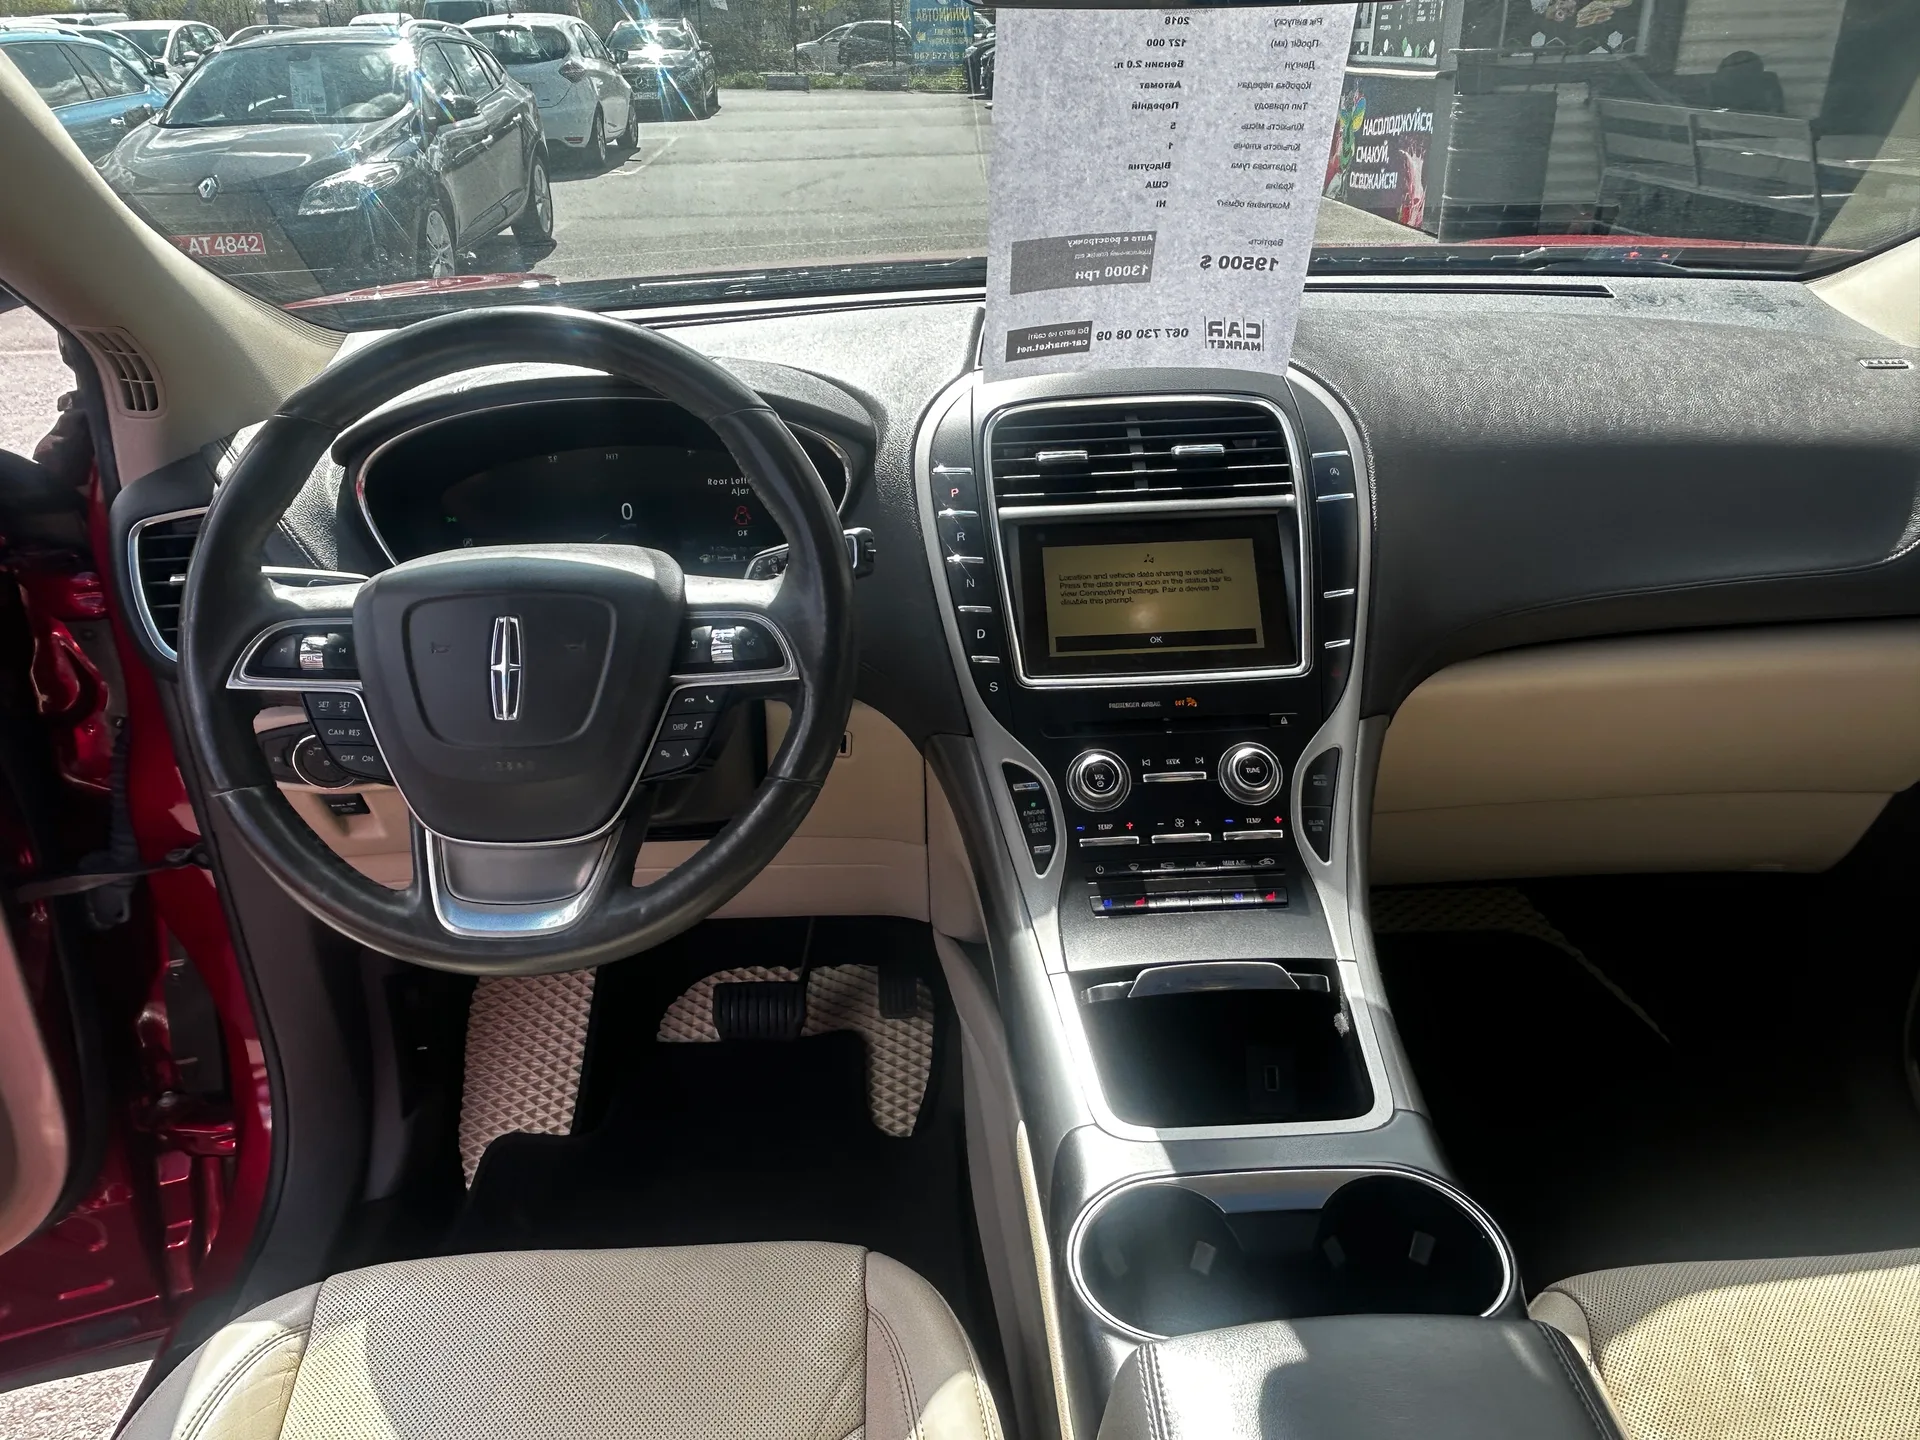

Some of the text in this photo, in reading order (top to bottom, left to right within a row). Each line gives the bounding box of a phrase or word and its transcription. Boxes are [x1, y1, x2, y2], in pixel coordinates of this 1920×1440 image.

[916, 3, 971, 21] АВТОМИЙКА
[1363, 107, 1433, 136] НАСОЛОДЖУЙСЯ,
[1356, 140, 1389, 163] СМАКУЙ,
[189, 235, 261, 255] AT 4842
[732, 487, 749, 496] Ajar
[951, 488, 959, 497] P
[622, 503, 633, 520] 0
[957, 532, 966, 541] R
[1059, 573, 1092, 582] Location
[1094, 572, 1108, 580] and
[1109, 571, 1135, 579] vehicle
[967, 579, 975, 588] N
[1080, 589, 1126, 597] Connectivity
[977, 629, 986, 639] D
[1150, 635, 1163, 644] OK
[990, 682, 998, 692] S
[673, 723, 688, 731] DISP
